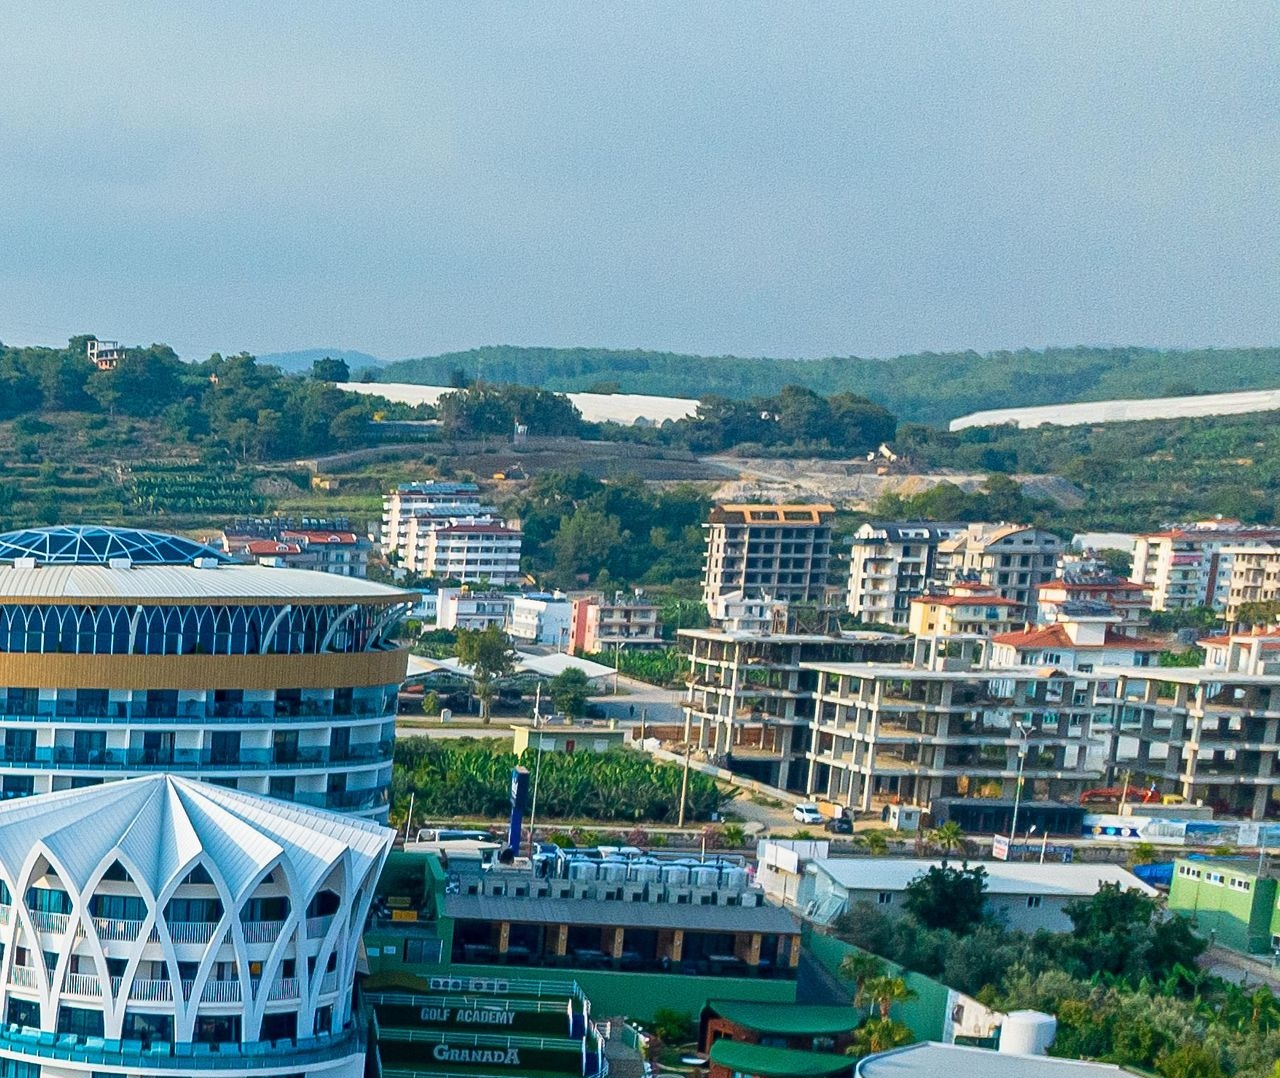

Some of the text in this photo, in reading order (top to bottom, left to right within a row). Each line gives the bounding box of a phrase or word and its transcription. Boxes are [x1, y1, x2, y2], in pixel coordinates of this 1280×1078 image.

[420, 1007, 515, 1024] GOLF ACADEMY
[433, 1045, 520, 1064] GRANADA
